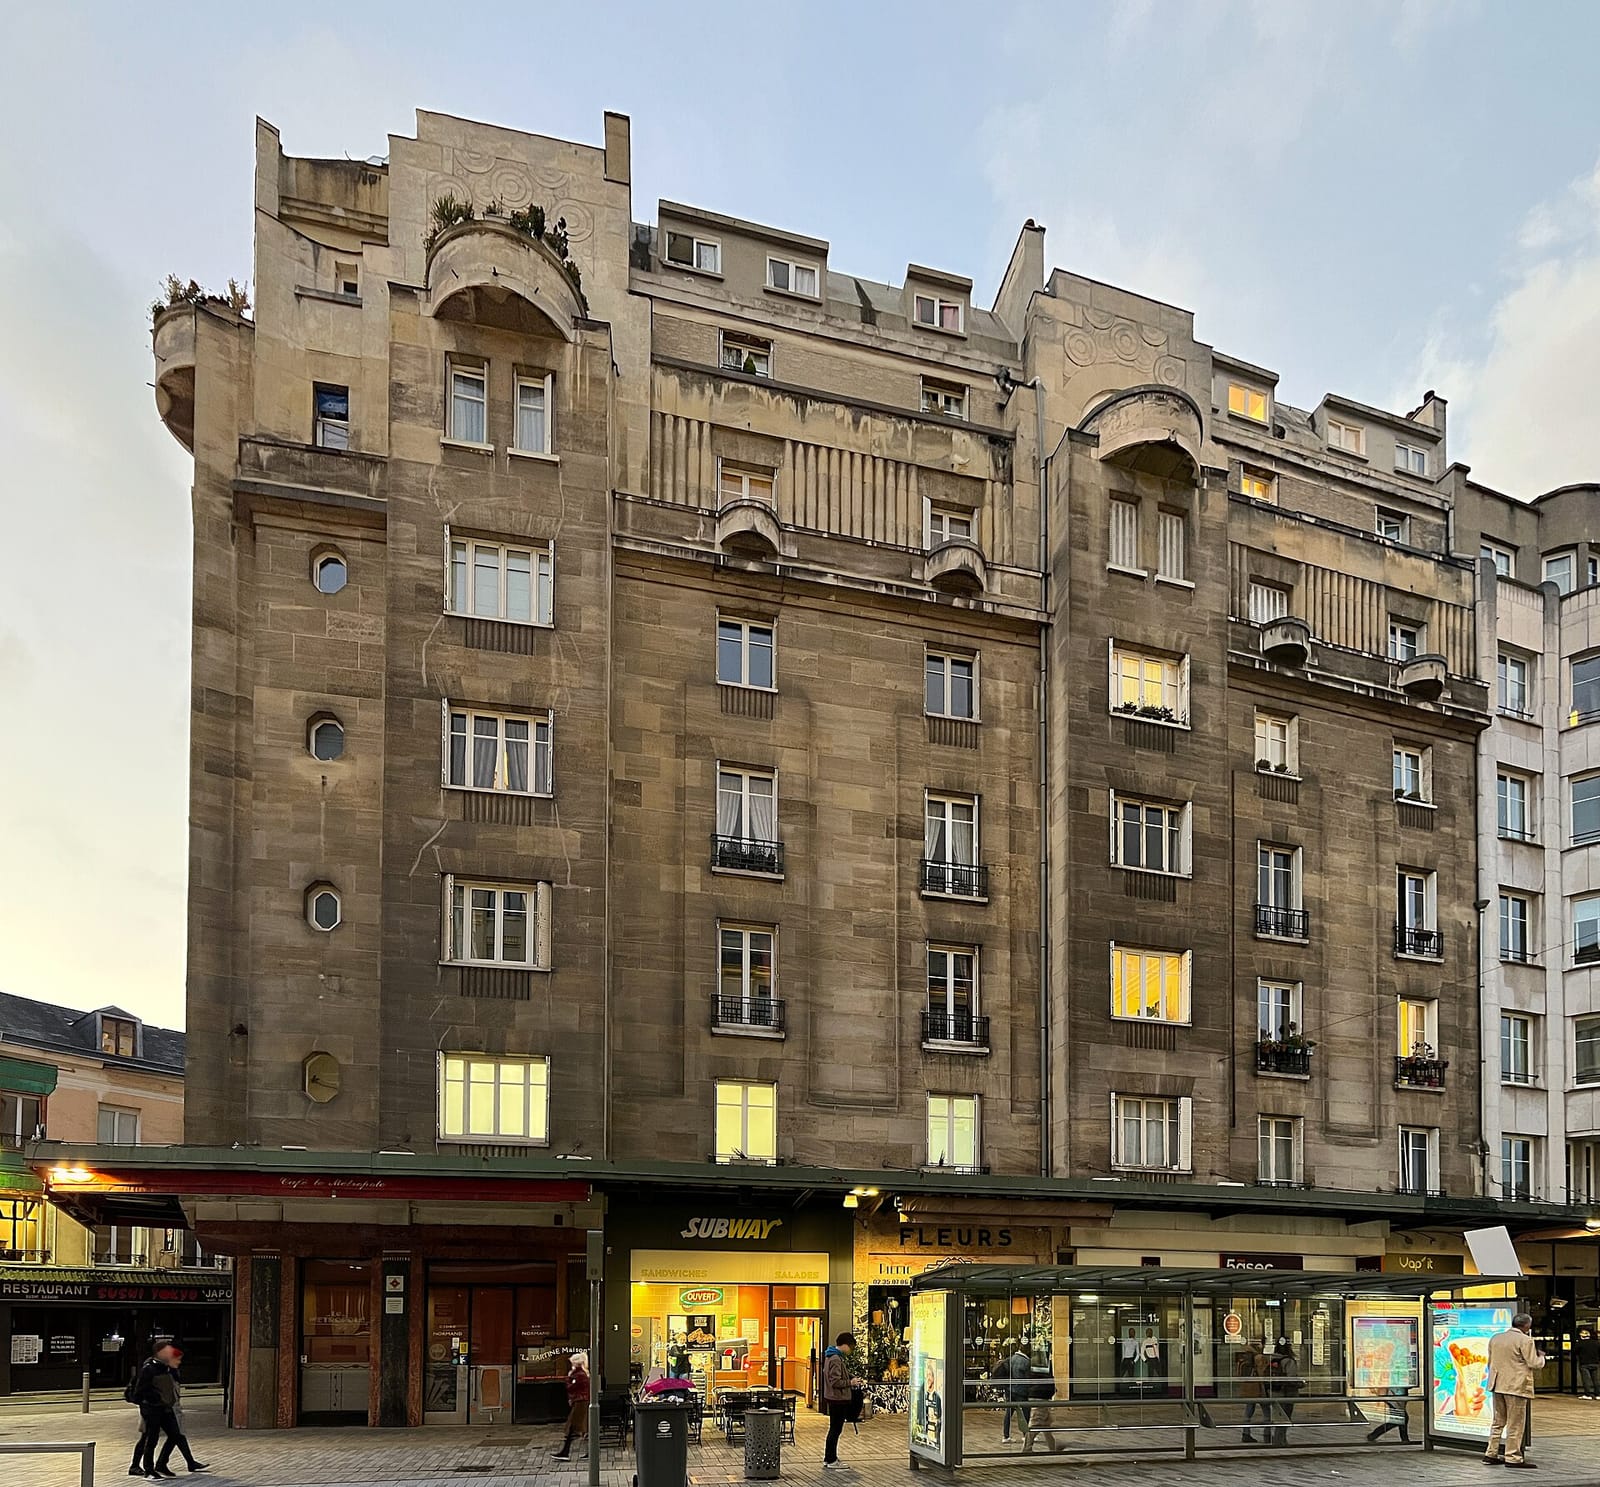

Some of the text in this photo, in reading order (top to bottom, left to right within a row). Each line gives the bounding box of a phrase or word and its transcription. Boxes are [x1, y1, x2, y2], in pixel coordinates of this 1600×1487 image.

[681, 1217, 783, 1239] SUBWAY
[899, 1227, 1013, 1247] FLEURS
[641, 1269, 819, 1279] SANDWICHES SALADES
[2, 1283, 91, 1296] RESTAURANT
[97, 1287, 145, 1299] SUSHI
[687, 1292, 715, 1301] OUVERT
